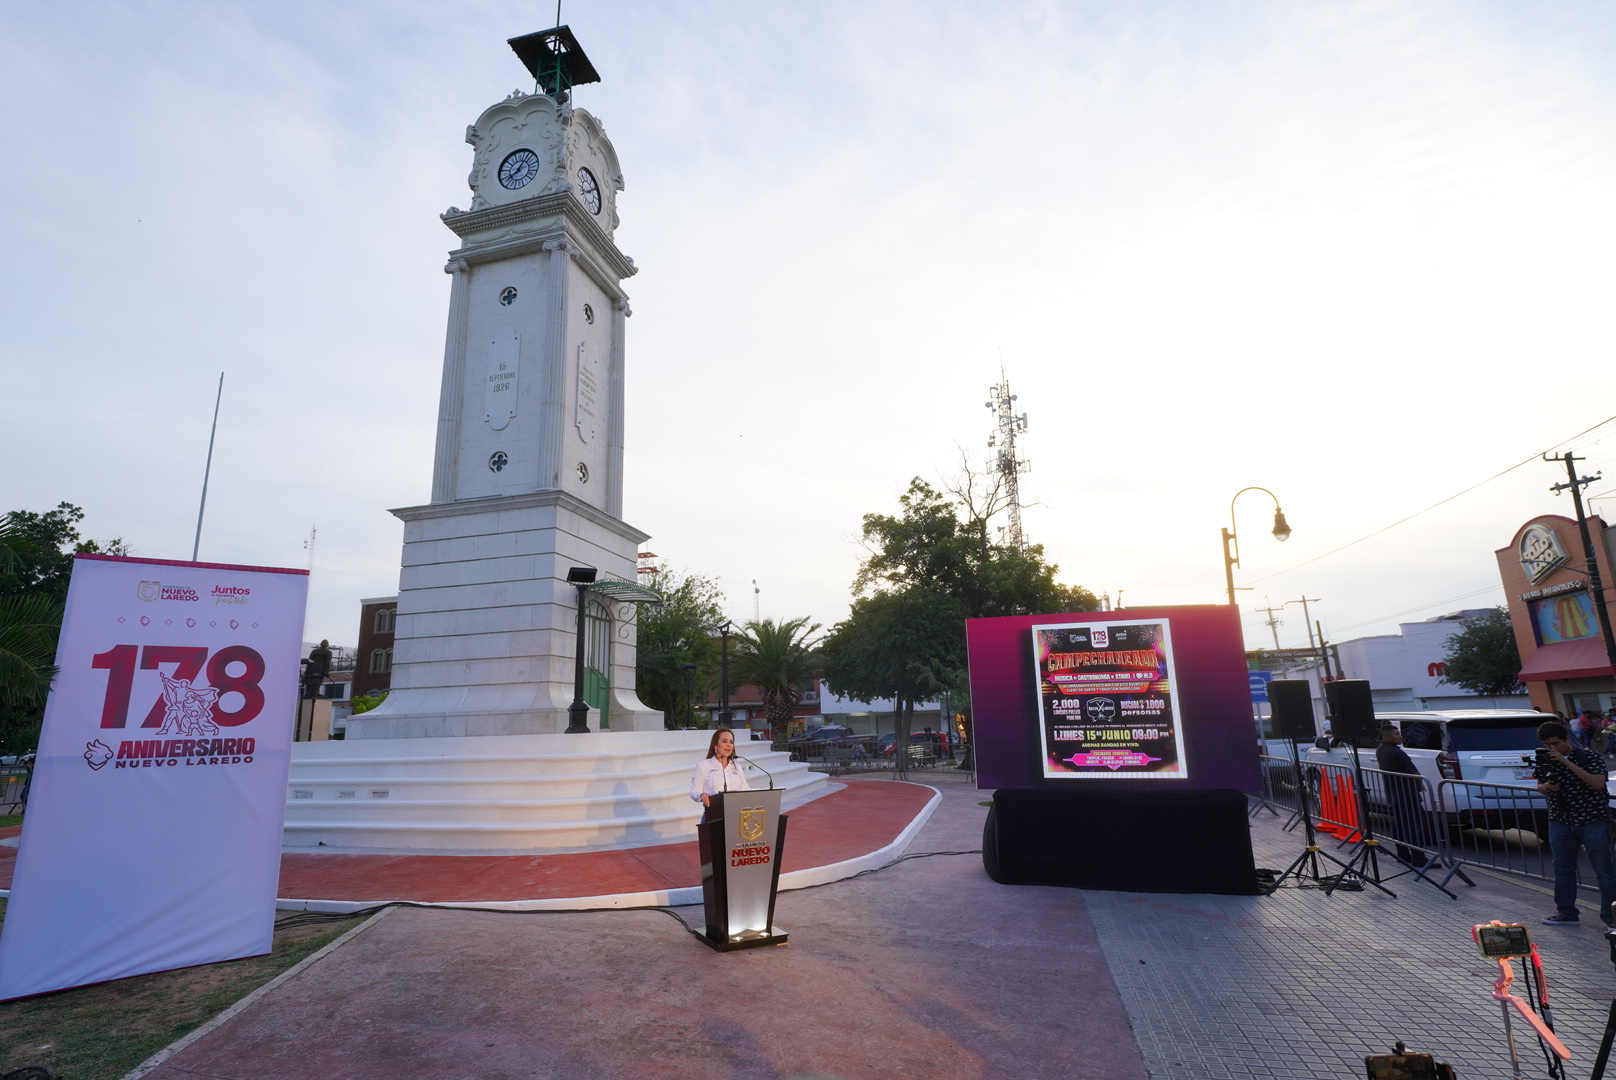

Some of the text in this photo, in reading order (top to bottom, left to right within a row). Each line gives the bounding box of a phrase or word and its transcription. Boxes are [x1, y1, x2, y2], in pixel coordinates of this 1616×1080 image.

[489, 372, 516, 382] SEPTIEMBRE
[494, 382, 510, 392] 1926
[211, 585, 250, 595] Juntos
[1542, 582, 1574, 595] INFANTILES
[215, 596, 248, 606] posible
[1048, 650, 1160, 671] CAMPECHANEADA
[92, 644, 265, 729] 178
[1052, 699, 1080, 710] 2,000
[1145, 700, 1164, 709] 1000
[1054, 730, 1085, 740] LUNES
[1086, 730, 1096, 740] 15
[1102, 730, 1131, 740] JUNIO
[1132, 729, 1159, 740] 08:00
[116, 738, 256, 759] ANIVERSARIO
[115, 756, 254, 769] NUEVO LAREDO
[732, 846, 770, 858] NUEVO
[732, 856, 770, 867] LAREDO
